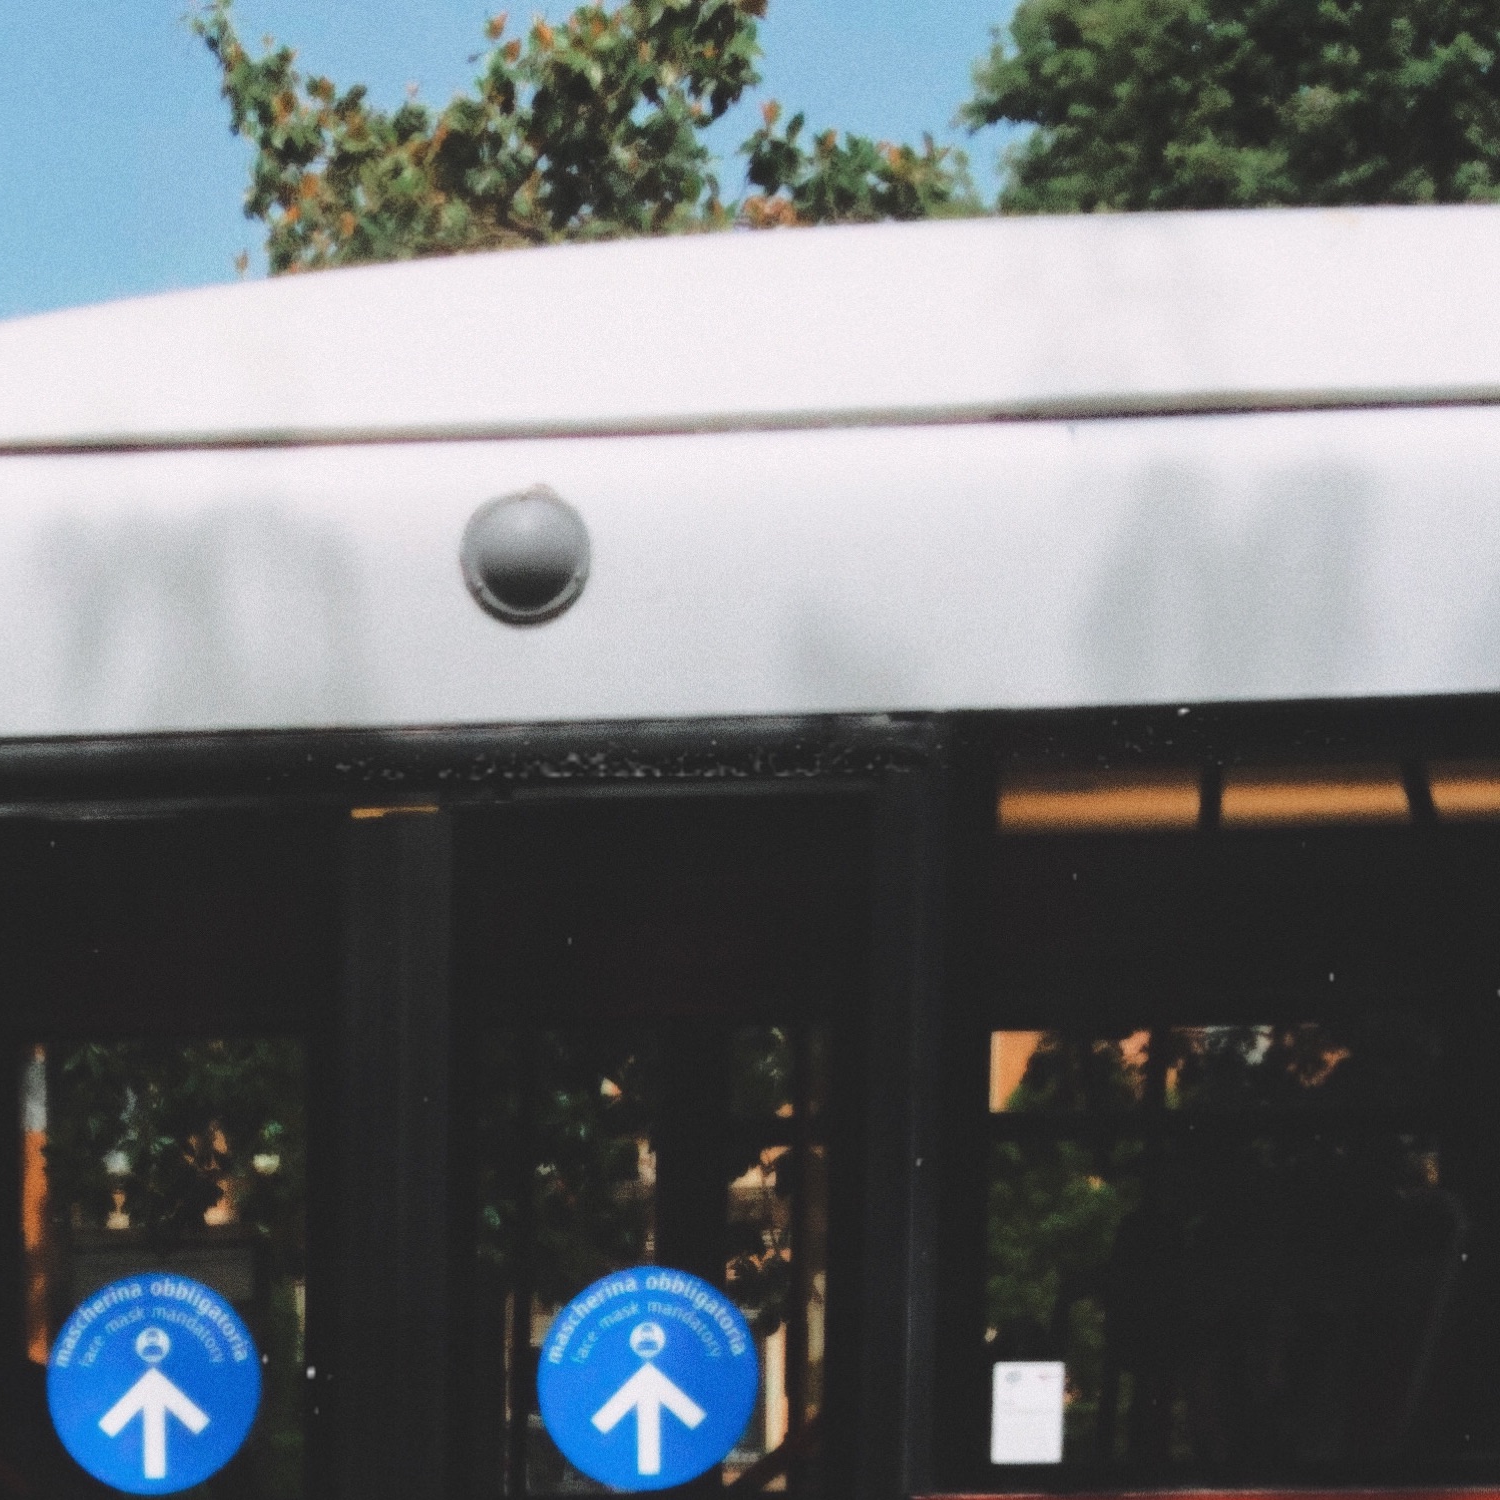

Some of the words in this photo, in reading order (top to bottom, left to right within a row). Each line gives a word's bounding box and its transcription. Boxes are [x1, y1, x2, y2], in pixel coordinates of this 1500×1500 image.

[55, 1282, 143, 1368] mascherina
[150, 1278, 248, 1362] obbligatoria
[549, 1276, 638, 1365] mascherina
[645, 1272, 747, 1357] obbligatoria
